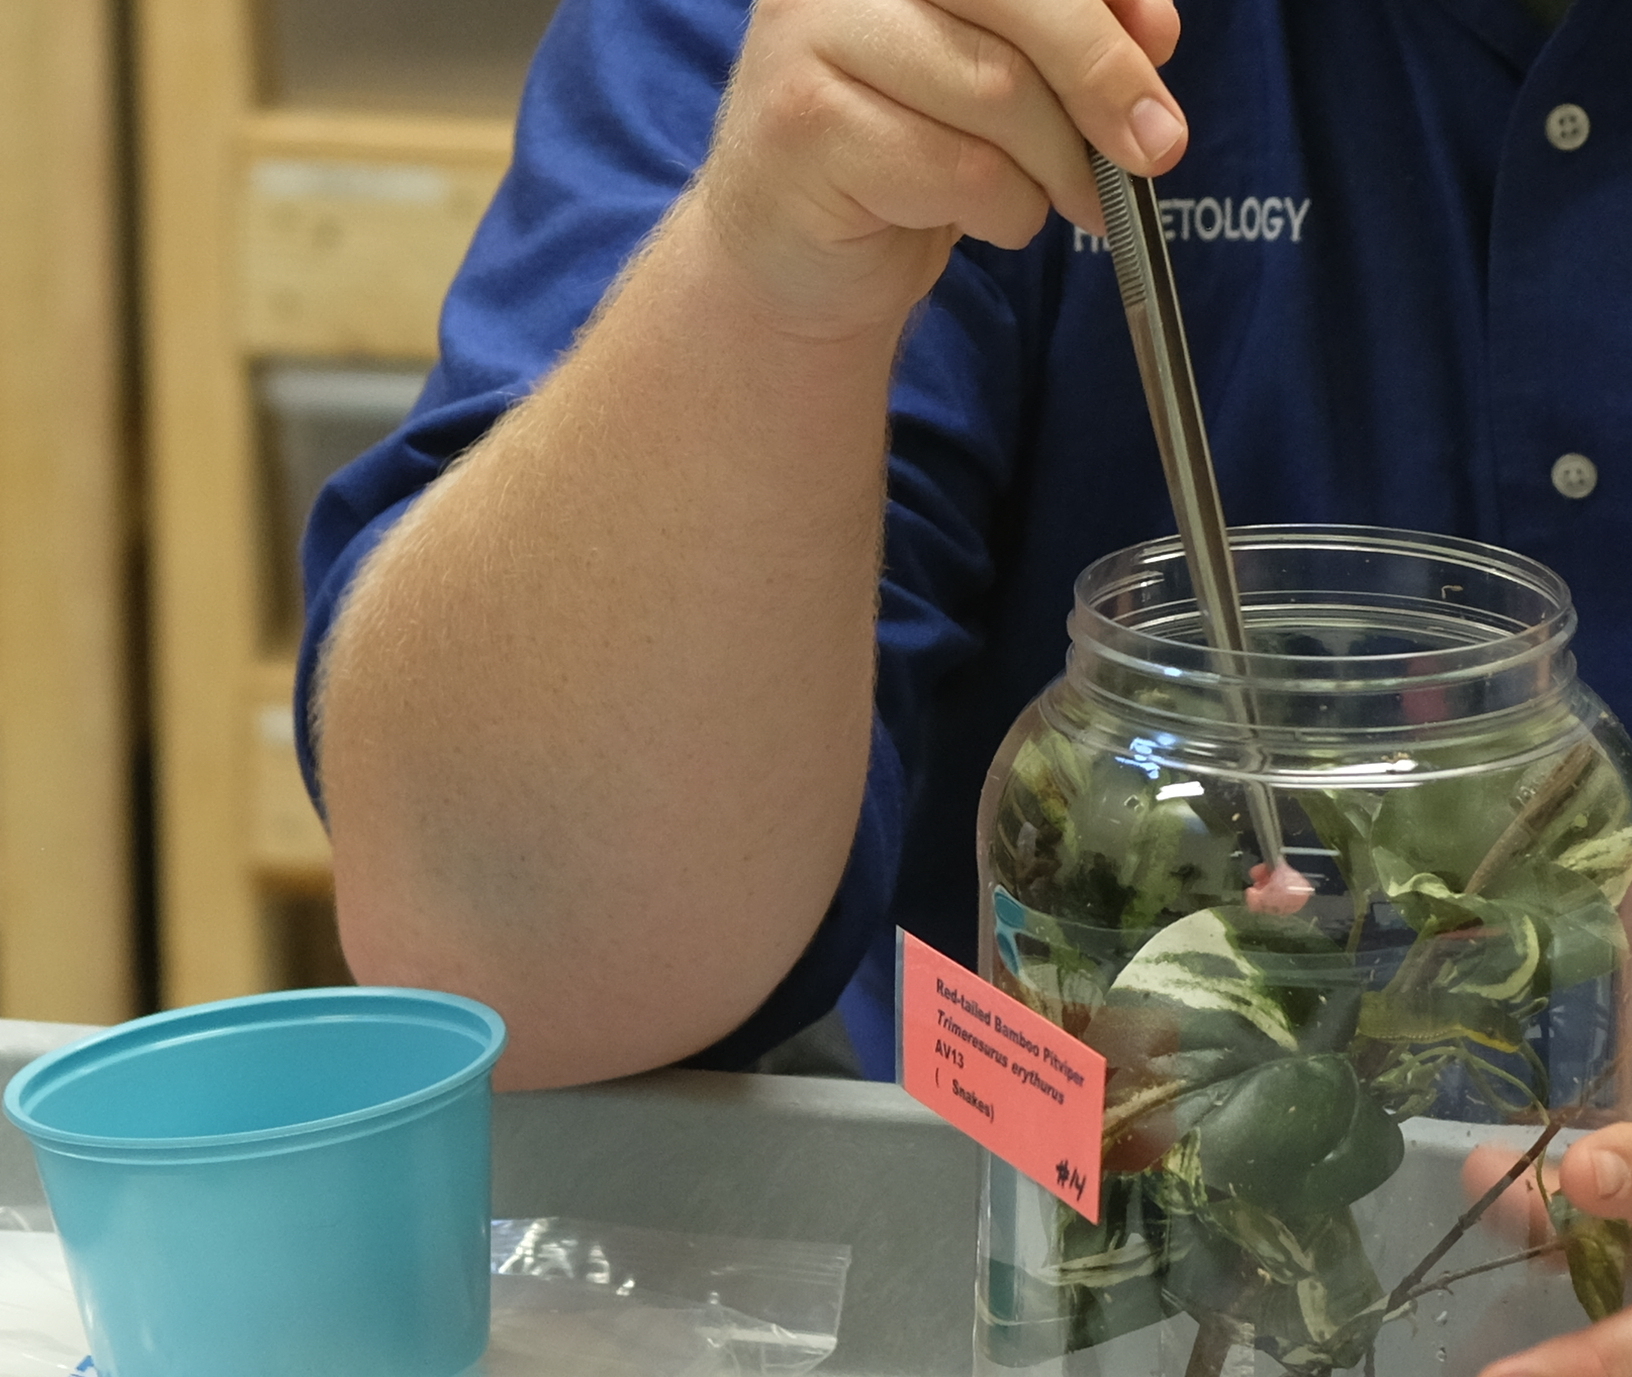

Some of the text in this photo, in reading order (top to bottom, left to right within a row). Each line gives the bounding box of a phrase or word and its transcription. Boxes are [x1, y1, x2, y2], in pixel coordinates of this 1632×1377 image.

[1073, 196, 1311, 253] HETOLOGY
[935, 1038, 964, 1069] AV13
[936, 977, 1085, 1087] Red-tailed Bamboo Pitviper
[937, 1009, 1064, 1105] Trimeresurus erythurus
[952, 1078, 995, 1124] Snakes)
[1055, 1158, 1086, 1202] #14
